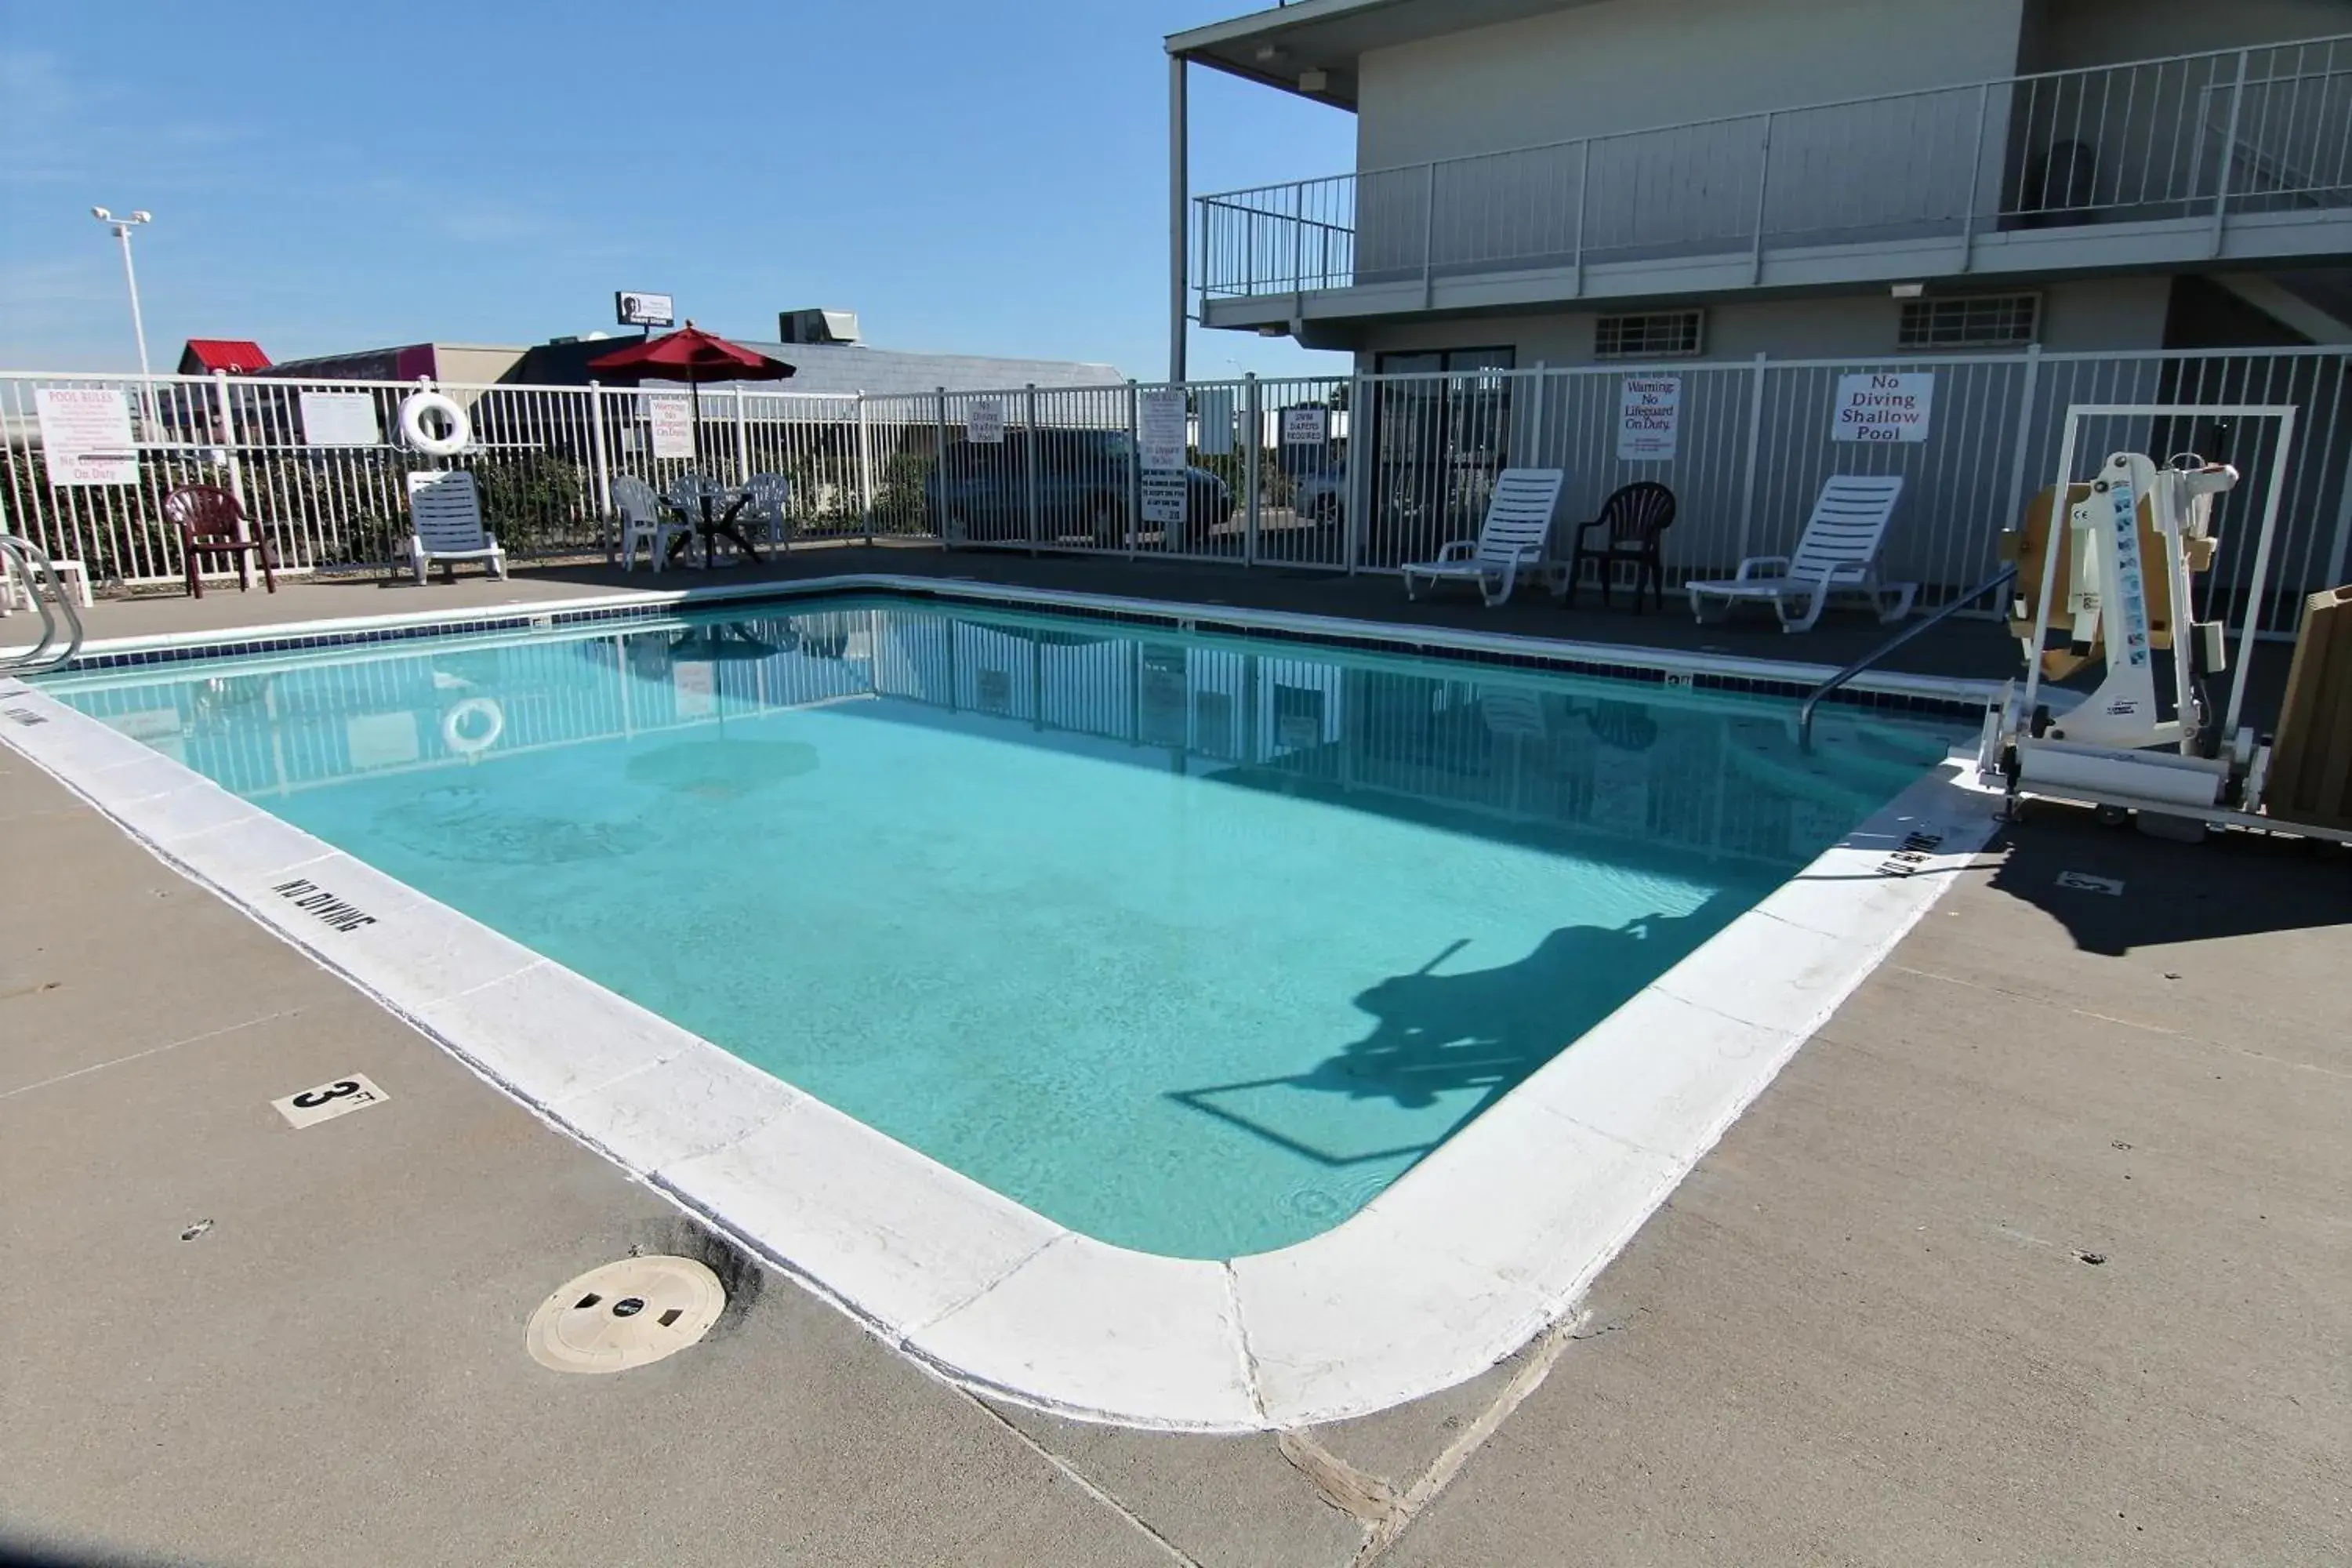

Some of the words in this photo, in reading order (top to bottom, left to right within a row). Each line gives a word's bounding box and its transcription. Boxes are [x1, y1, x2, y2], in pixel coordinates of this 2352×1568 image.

[1871, 375, 1900, 389] No
[49, 391, 78, 404] POOL
[80, 391, 114, 404] RULES
[1642, 394, 1659, 405] No
[1851, 392, 1916, 410] Diving
[1624, 405, 1674, 420] Lifeguard
[1841, 408, 1920, 424] Shallow
[1625, 418, 1642, 430] On
[1856, 426, 1900, 440] Pool
[270, 878, 319, 898] NO
[295, 892, 377, 932] DIVING
[292, 1081, 361, 1108] 3
[346, 1091, 376, 1105] FT
